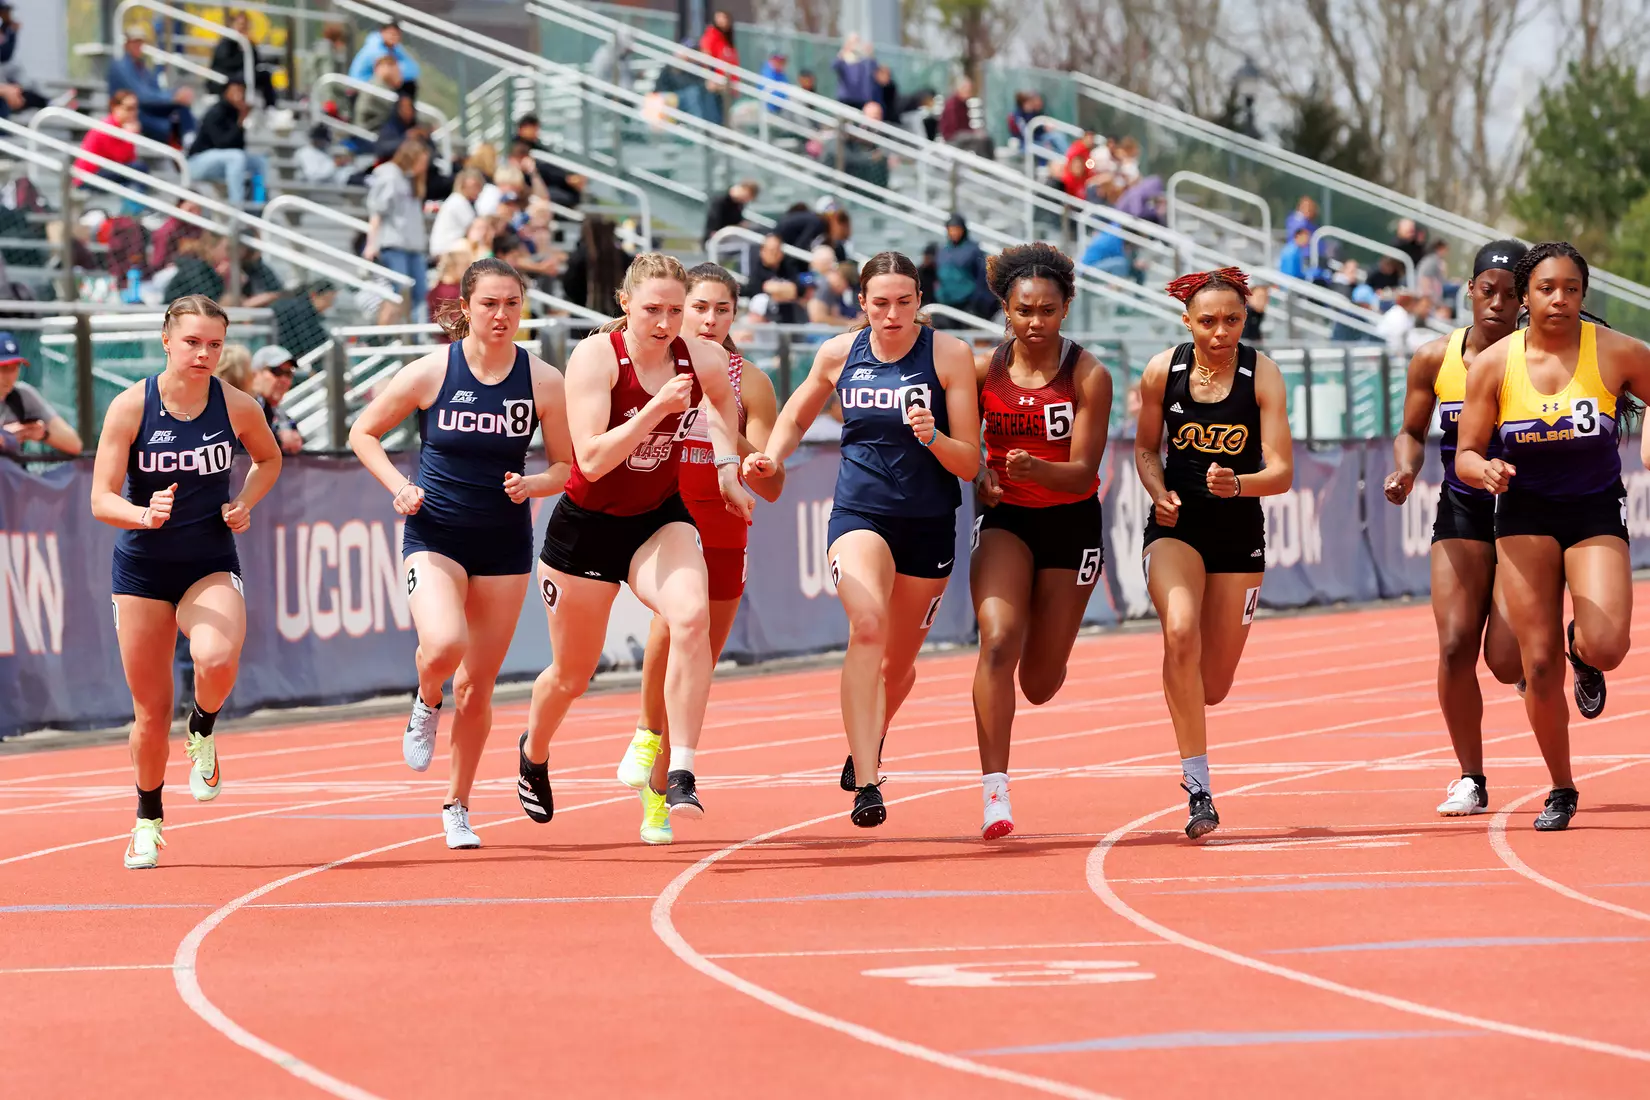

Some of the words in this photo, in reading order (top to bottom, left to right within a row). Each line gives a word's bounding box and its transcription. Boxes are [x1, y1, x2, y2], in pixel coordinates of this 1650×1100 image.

[842, 387, 932, 409] UCO
[438, 409, 508, 434] UCON
[510, 402, 530, 434] 8
[679, 409, 699, 439] 9
[986, 411, 1046, 436] NORTHEAST
[1049, 405, 1070, 438] 5
[1575, 400, 1597, 434] 3
[1515, 428, 1575, 443] UALBA
[199, 444, 227, 473] 10
[407, 567, 417, 595] 8
[1080, 551, 1098, 583] 5
[543, 579, 558, 607] 9
[1245, 589, 1258, 621] 4
